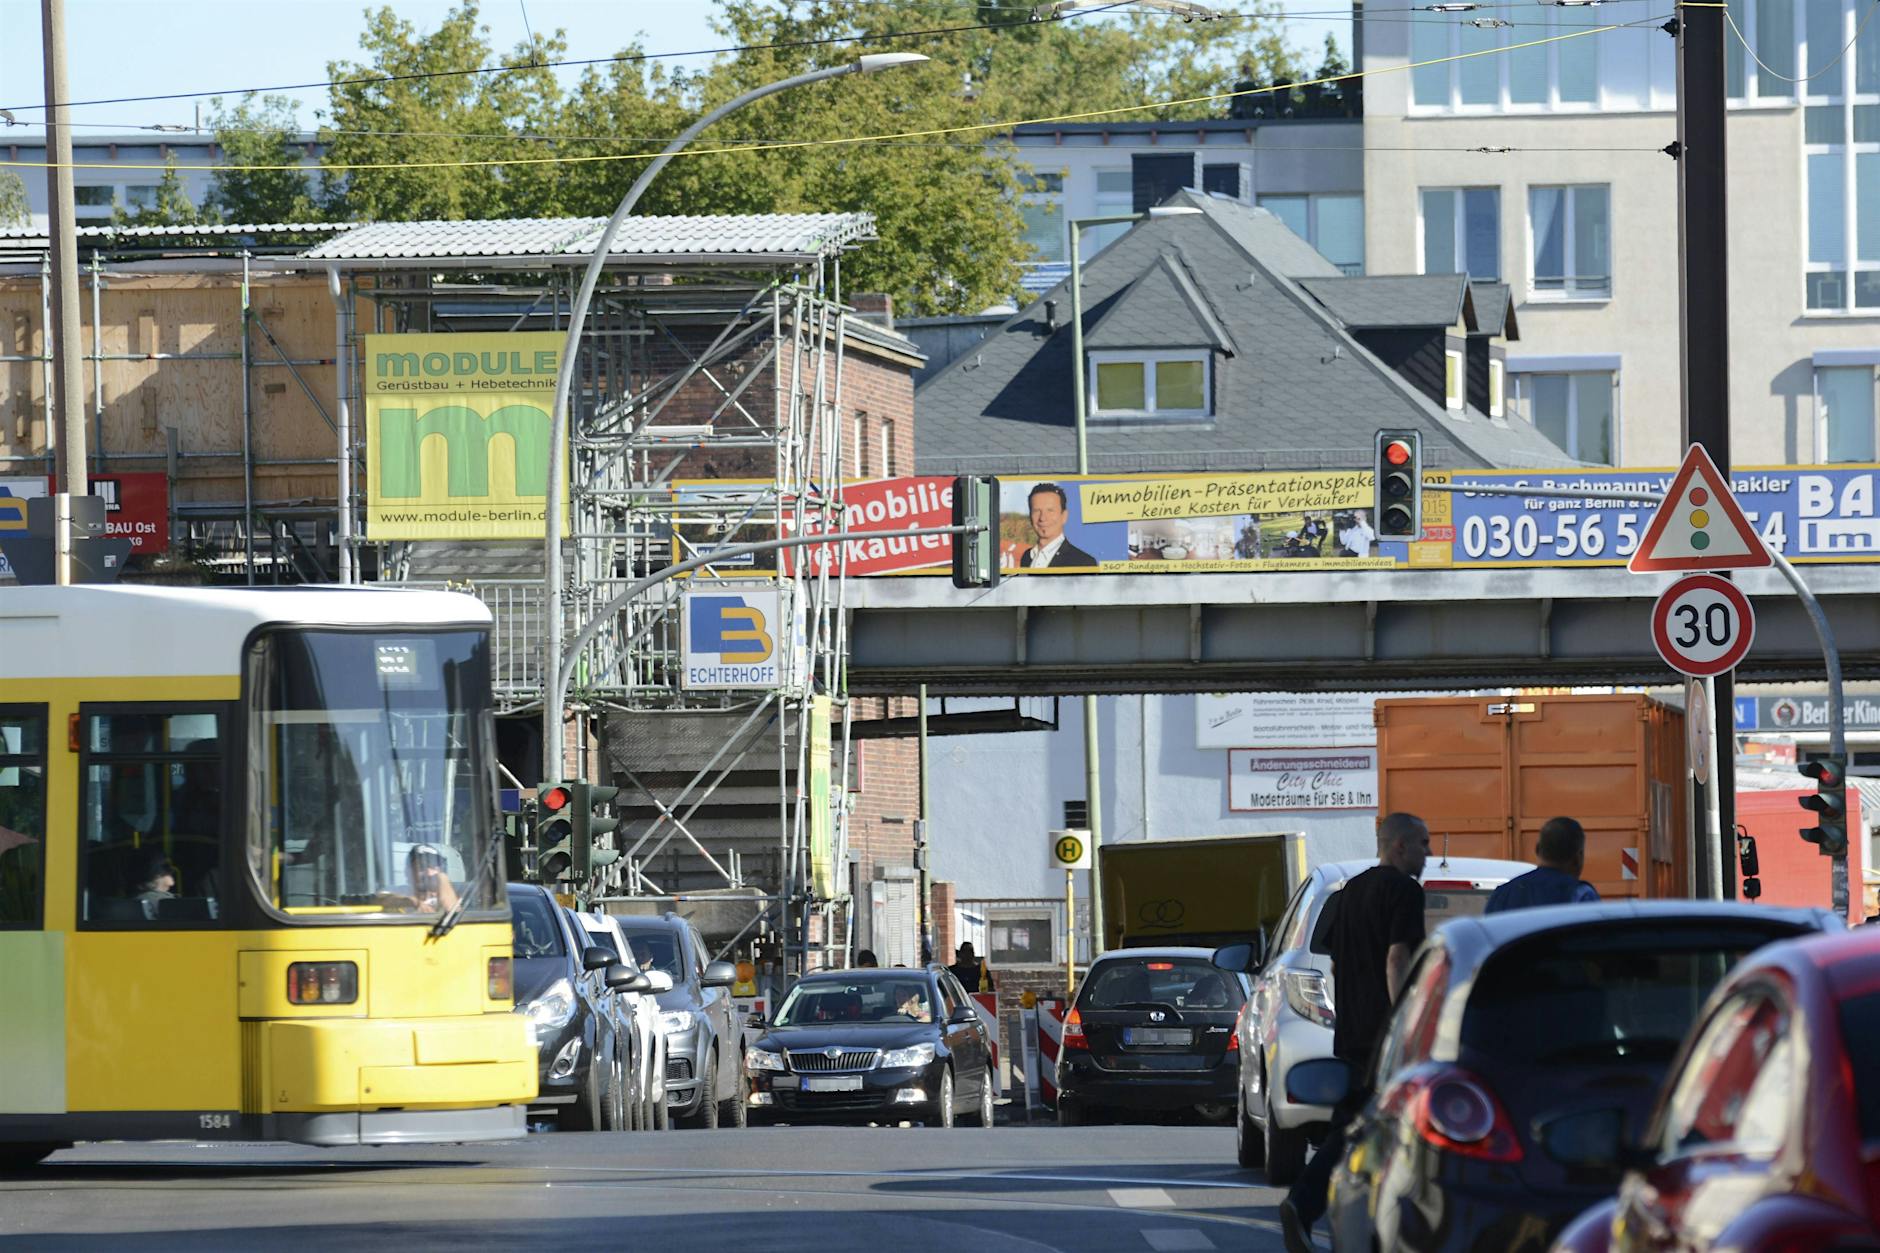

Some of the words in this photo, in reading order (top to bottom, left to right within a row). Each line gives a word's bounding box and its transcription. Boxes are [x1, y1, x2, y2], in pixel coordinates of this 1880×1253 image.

[376, 379, 449, 391] Gerüstbau
[455, 381, 465, 389] +
[471, 378, 557, 390] Hebetechnik
[1090, 472, 1375, 506] Immobilien-Präsentationspake
[1141, 503, 1181, 518] keine
[1188, 500, 1240, 514] Kosten
[1248, 496, 1271, 511] für
[1278, 491, 1360, 508] Verkäufer!
[1422, 501, 1447, 514] 015
[1524, 499, 1544, 509] für
[1548, 501, 1581, 511] ganz
[1585, 499, 1625, 509] Berlin
[380, 509, 547, 523] www.module-berlin.d
[135, 522, 156, 534] Ost
[1463, 514, 1606, 558] 030-56
[1128, 562, 1170, 573] Rundgang
[1674, 602, 1731, 648] 30
[690, 667, 774, 683] ECHTERHOFF
[1802, 701, 1854, 724] Berler
[1855, 699, 1880, 724] Kin
[1252, 758, 1368, 770] Änderungsschneiderei
[1276, 772, 1306, 791] City
[1311, 771, 1343, 790] Chic
[1251, 792, 1311, 807] Modeträume
[1314, 791, 1328, 806] für
[1331, 792, 1345, 805] Sie
[1347, 791, 1354, 805] &
[1356, 792, 1372, 805] Ihn
[200, 1114, 231, 1128] 1584
